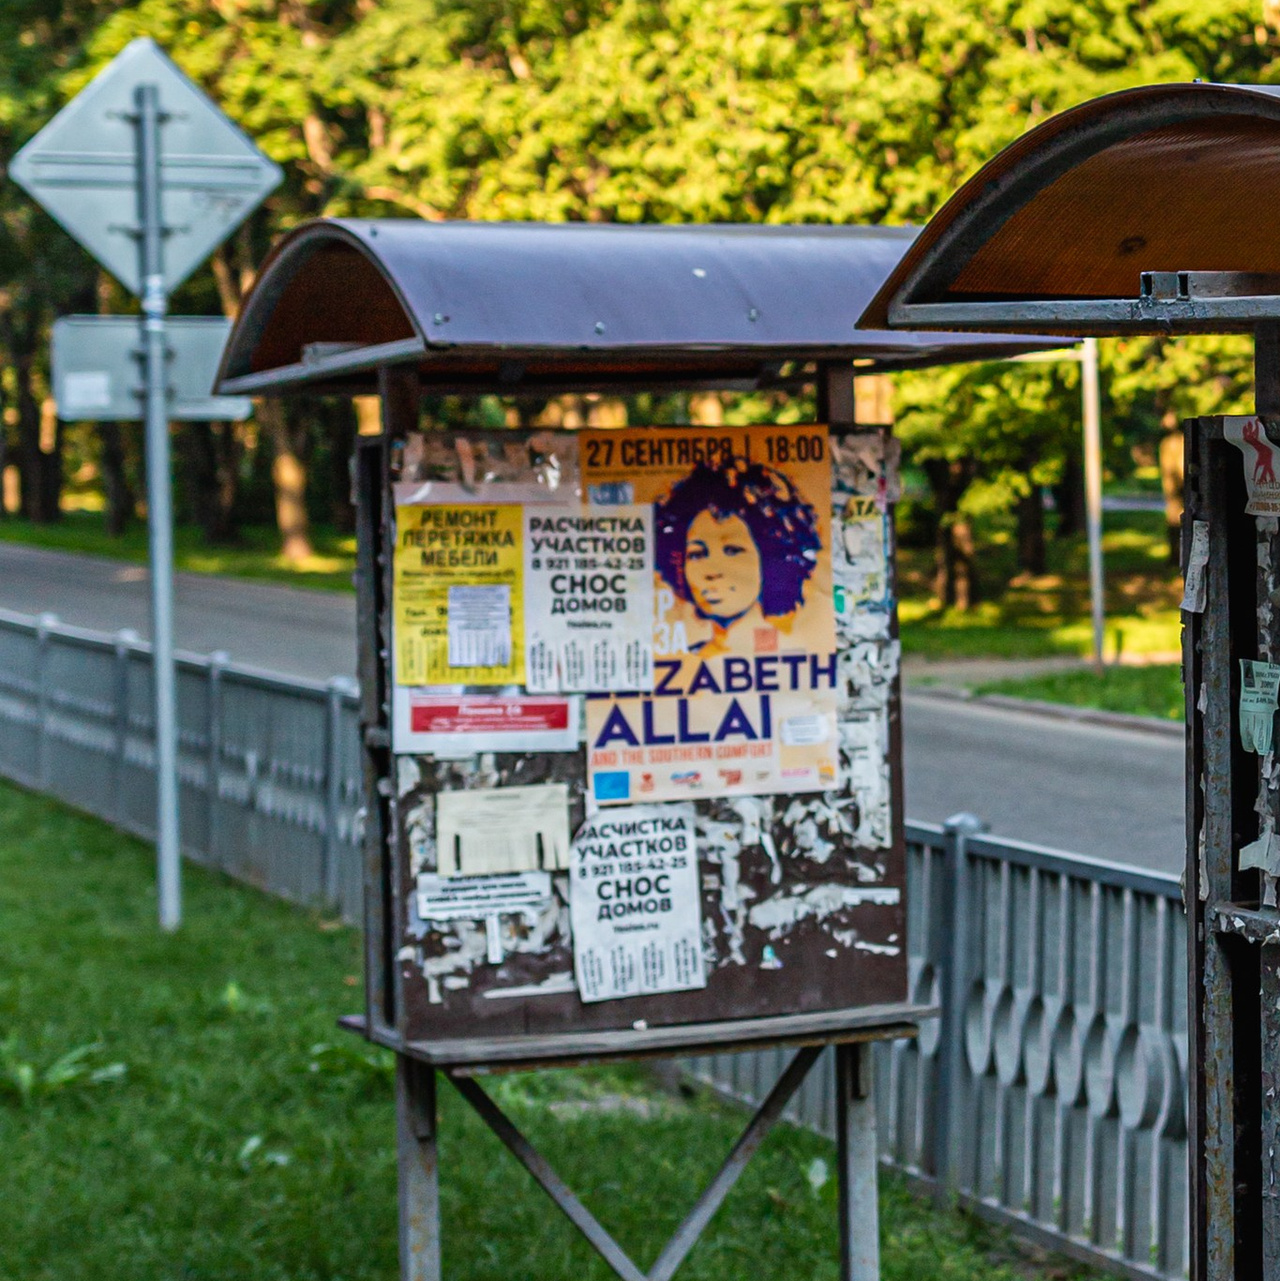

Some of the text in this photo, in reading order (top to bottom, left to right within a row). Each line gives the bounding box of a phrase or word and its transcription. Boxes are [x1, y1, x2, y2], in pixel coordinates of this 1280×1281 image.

[587, 435, 824, 466] 27 СЕНТЯБРЯ 18:00
[420, 509, 497, 527] РЕМОНТ
[529, 517, 645, 532] РАСЧИСТКА
[403, 529, 514, 548] ПЕРЕТЯЖКА
[531, 537, 646, 554] УЧАСТКОВ
[420, 549, 498, 567] МЕБЕЛИ
[546, 556, 569, 569] 921
[550, 574, 627, 594] СНОС
[550, 597, 627, 615] ДОМОВ
[587, 654, 838, 699] ZABETH
[595, 694, 773, 748] ALLAI
[592, 742, 773, 767] AND THE SOUTHERN COMFORT
[578, 836, 687, 863] УЧАСТКОВ
[597, 875, 671, 901] СНОС
[597, 898, 672, 922] ДОМОВ
